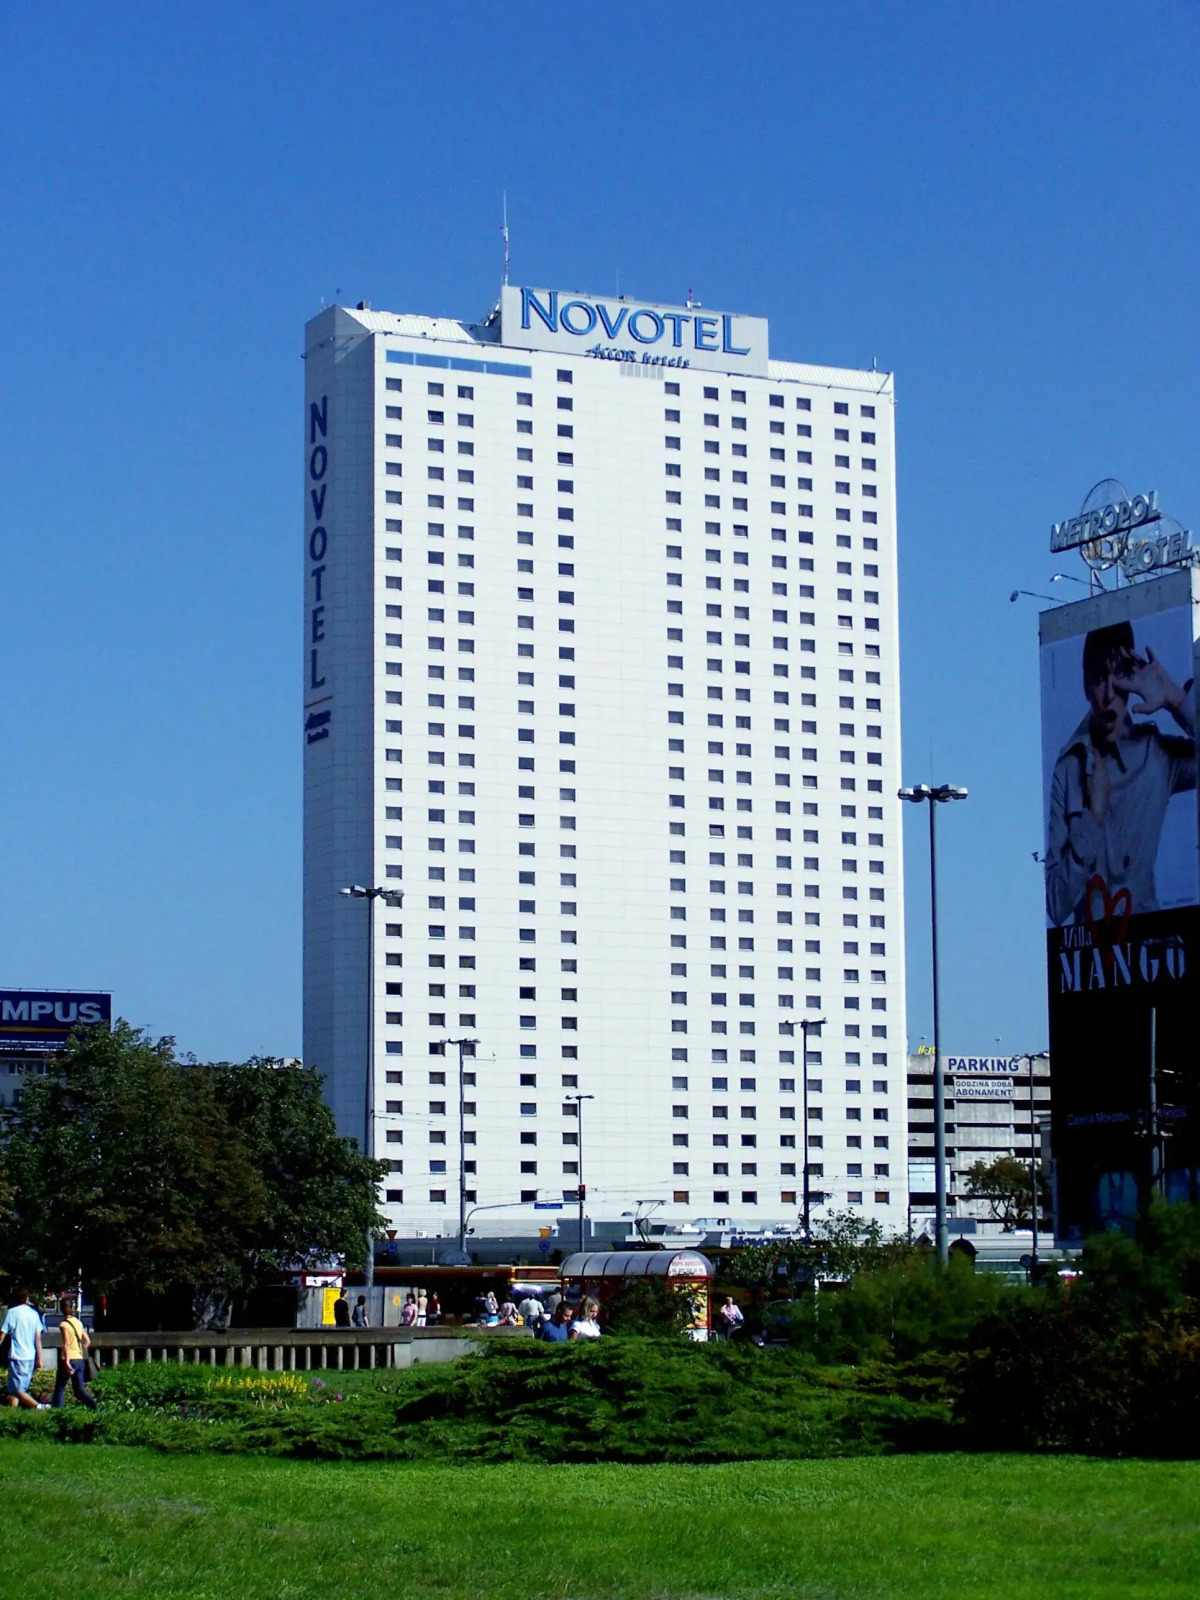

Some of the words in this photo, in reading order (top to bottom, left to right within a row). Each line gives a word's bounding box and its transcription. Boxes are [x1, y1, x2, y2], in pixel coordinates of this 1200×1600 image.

[520, 287, 752, 356] NOVOTEL
[641, 352, 691, 369] hotels
[309, 395, 329, 691] NOVOTEL
[1051, 490, 1163, 552] METROPOL
[1125, 529, 1195, 577] HOTEL
[1059, 934, 1186, 994] MANGO
[0, 999, 102, 1024] MPUS
[948, 1058, 1019, 1072] PARKING
[955, 1088, 1013, 1096] ABONAMENT
